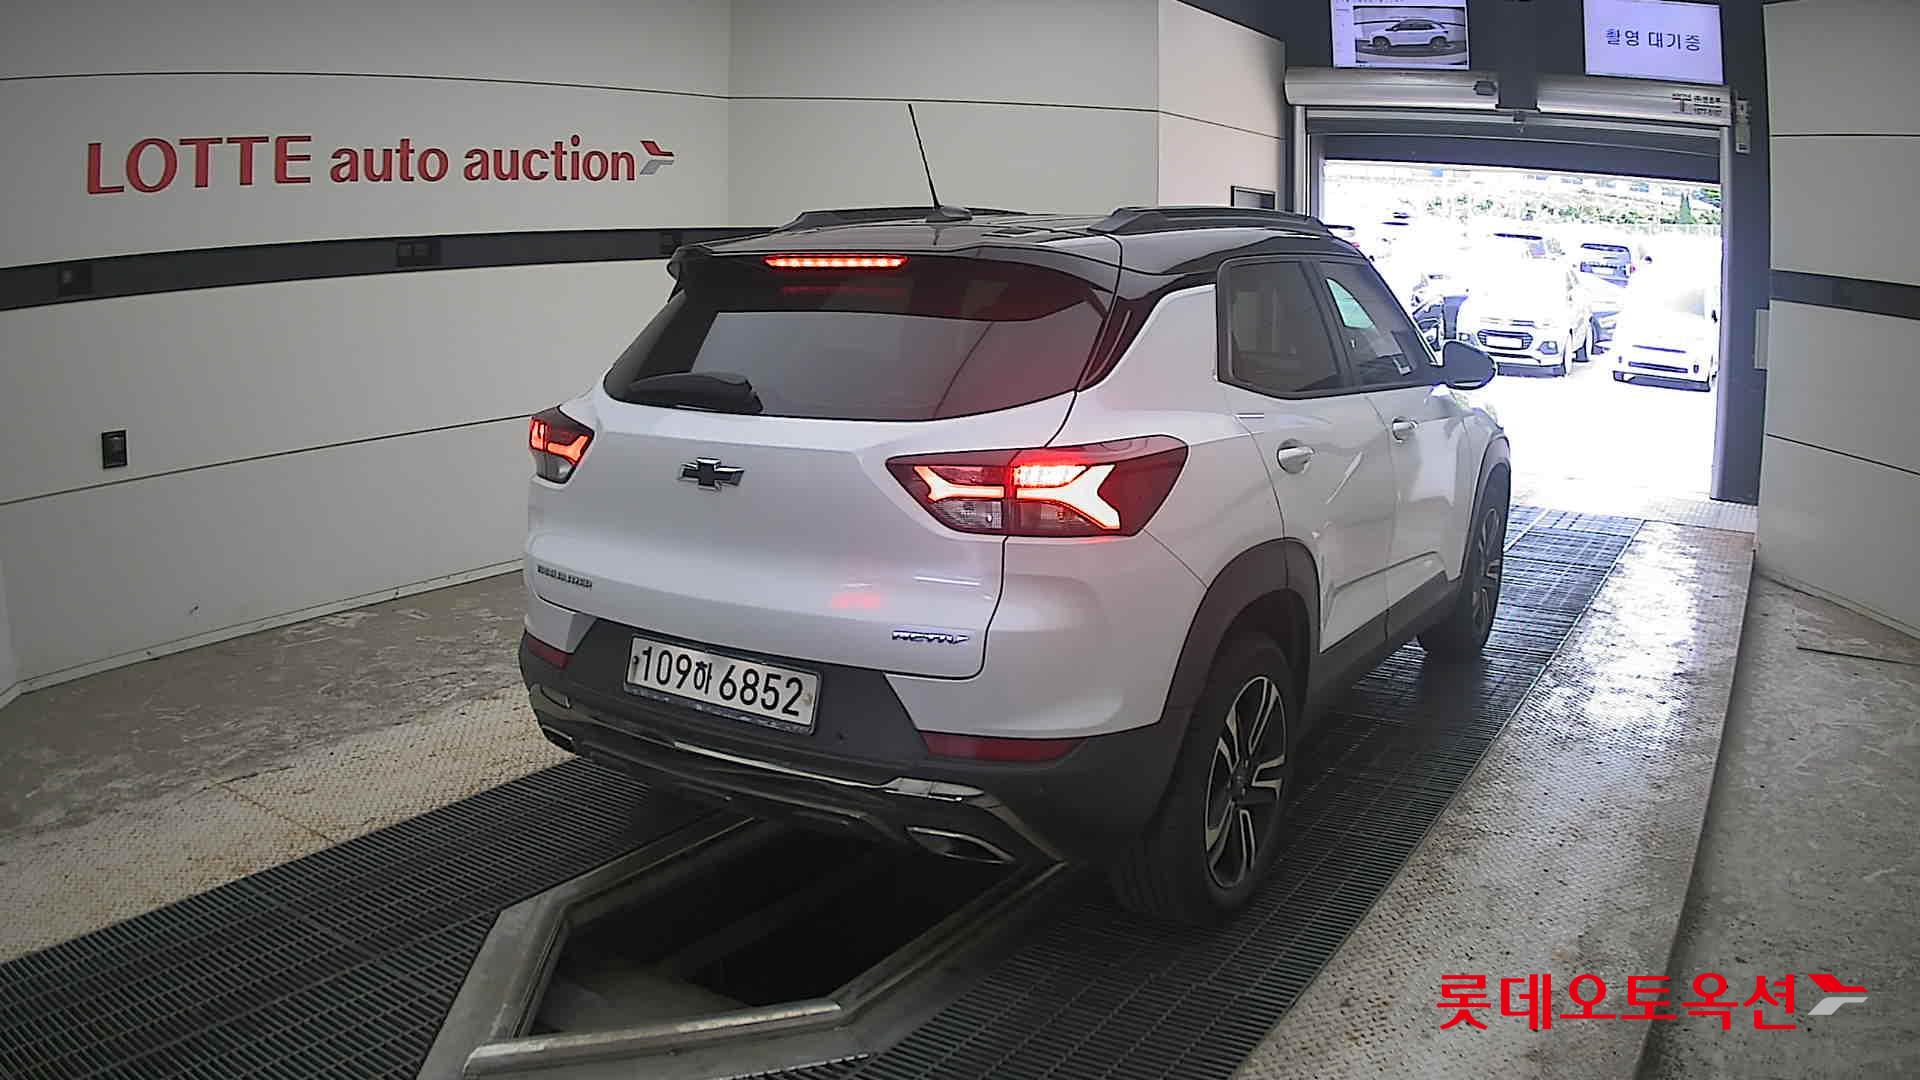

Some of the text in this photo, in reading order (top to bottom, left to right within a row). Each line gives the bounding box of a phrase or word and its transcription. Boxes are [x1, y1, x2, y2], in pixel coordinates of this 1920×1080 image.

[1606, 28, 1701, 52] 촬영 대기중
[86, 134, 637, 194] LOTTE auto auction
[719, 664, 804, 717] 6852
